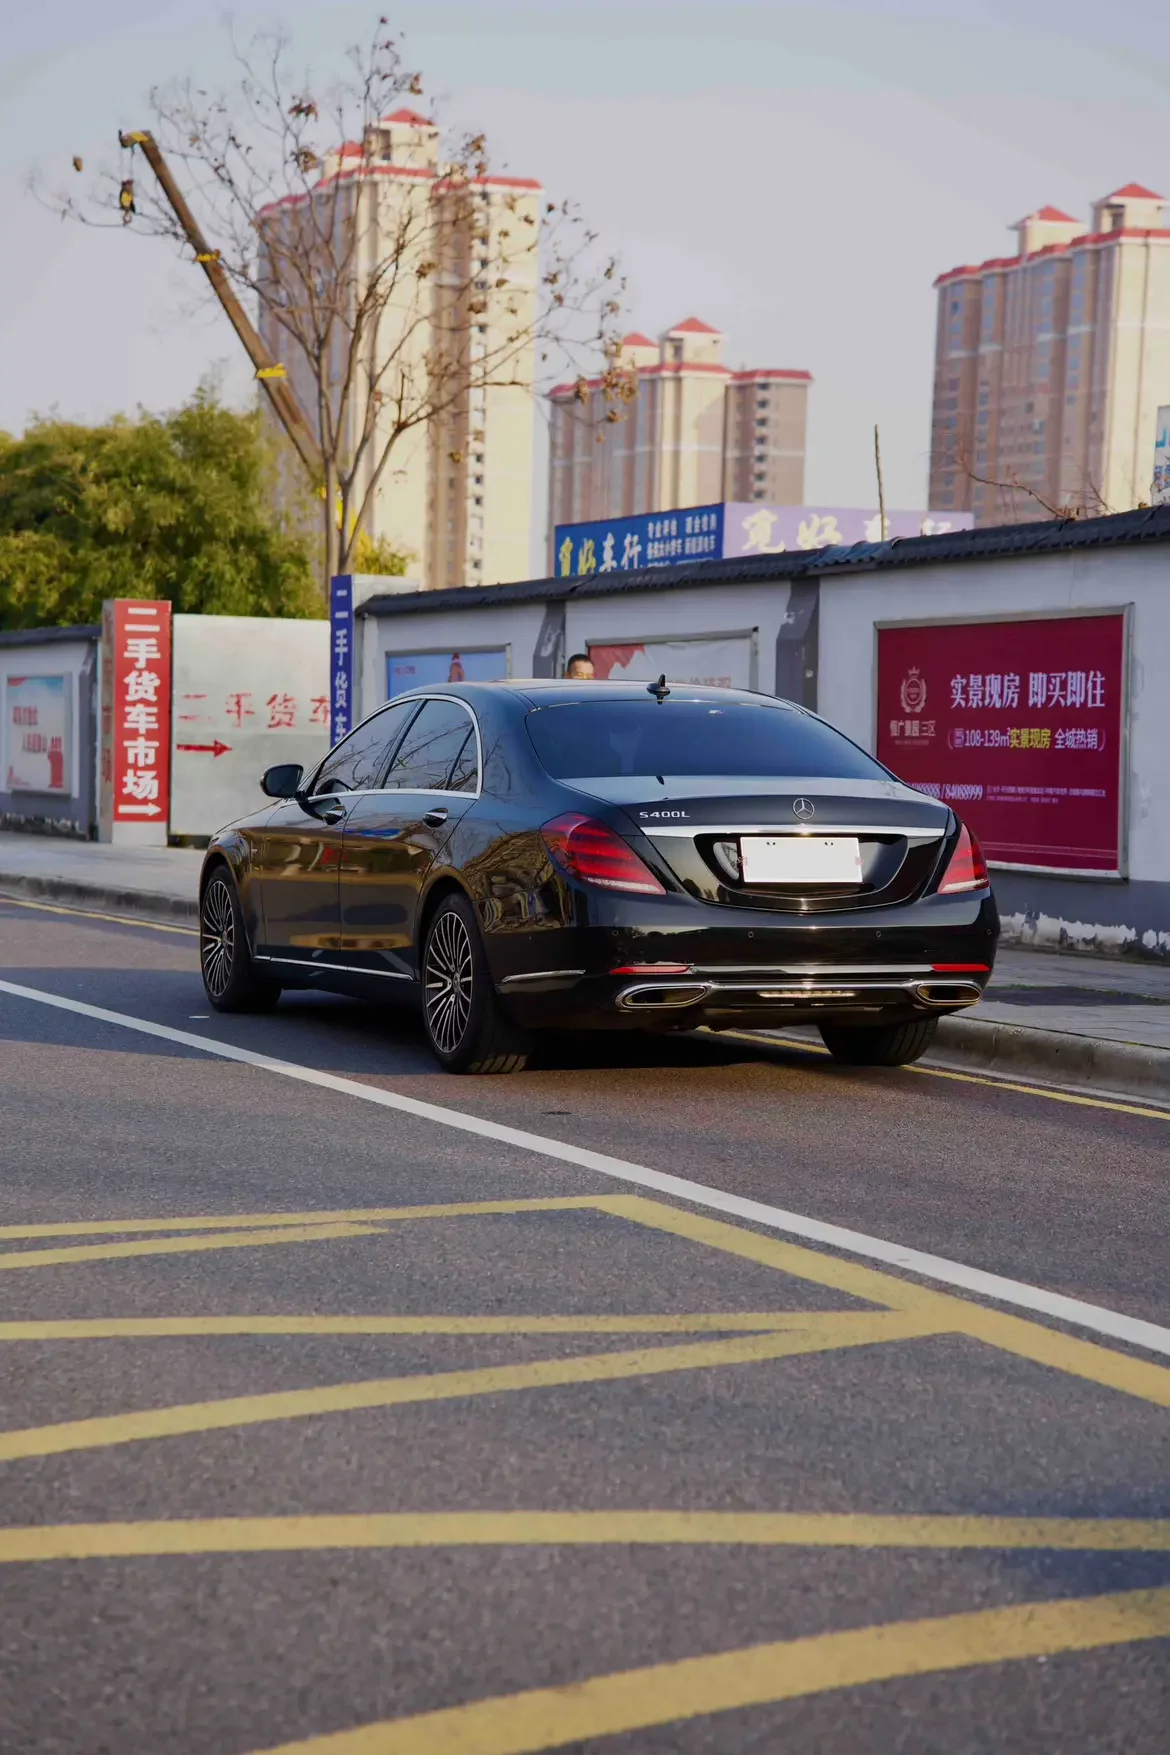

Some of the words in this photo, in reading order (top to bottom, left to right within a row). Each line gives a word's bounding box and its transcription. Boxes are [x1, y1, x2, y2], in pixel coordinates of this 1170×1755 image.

[122, 606, 162, 801] 二手货车市场
[950, 672, 1020, 709] 实景现房
[1028, 670, 1106, 709] 即买即住
[639, 810, 690, 819] S400L
